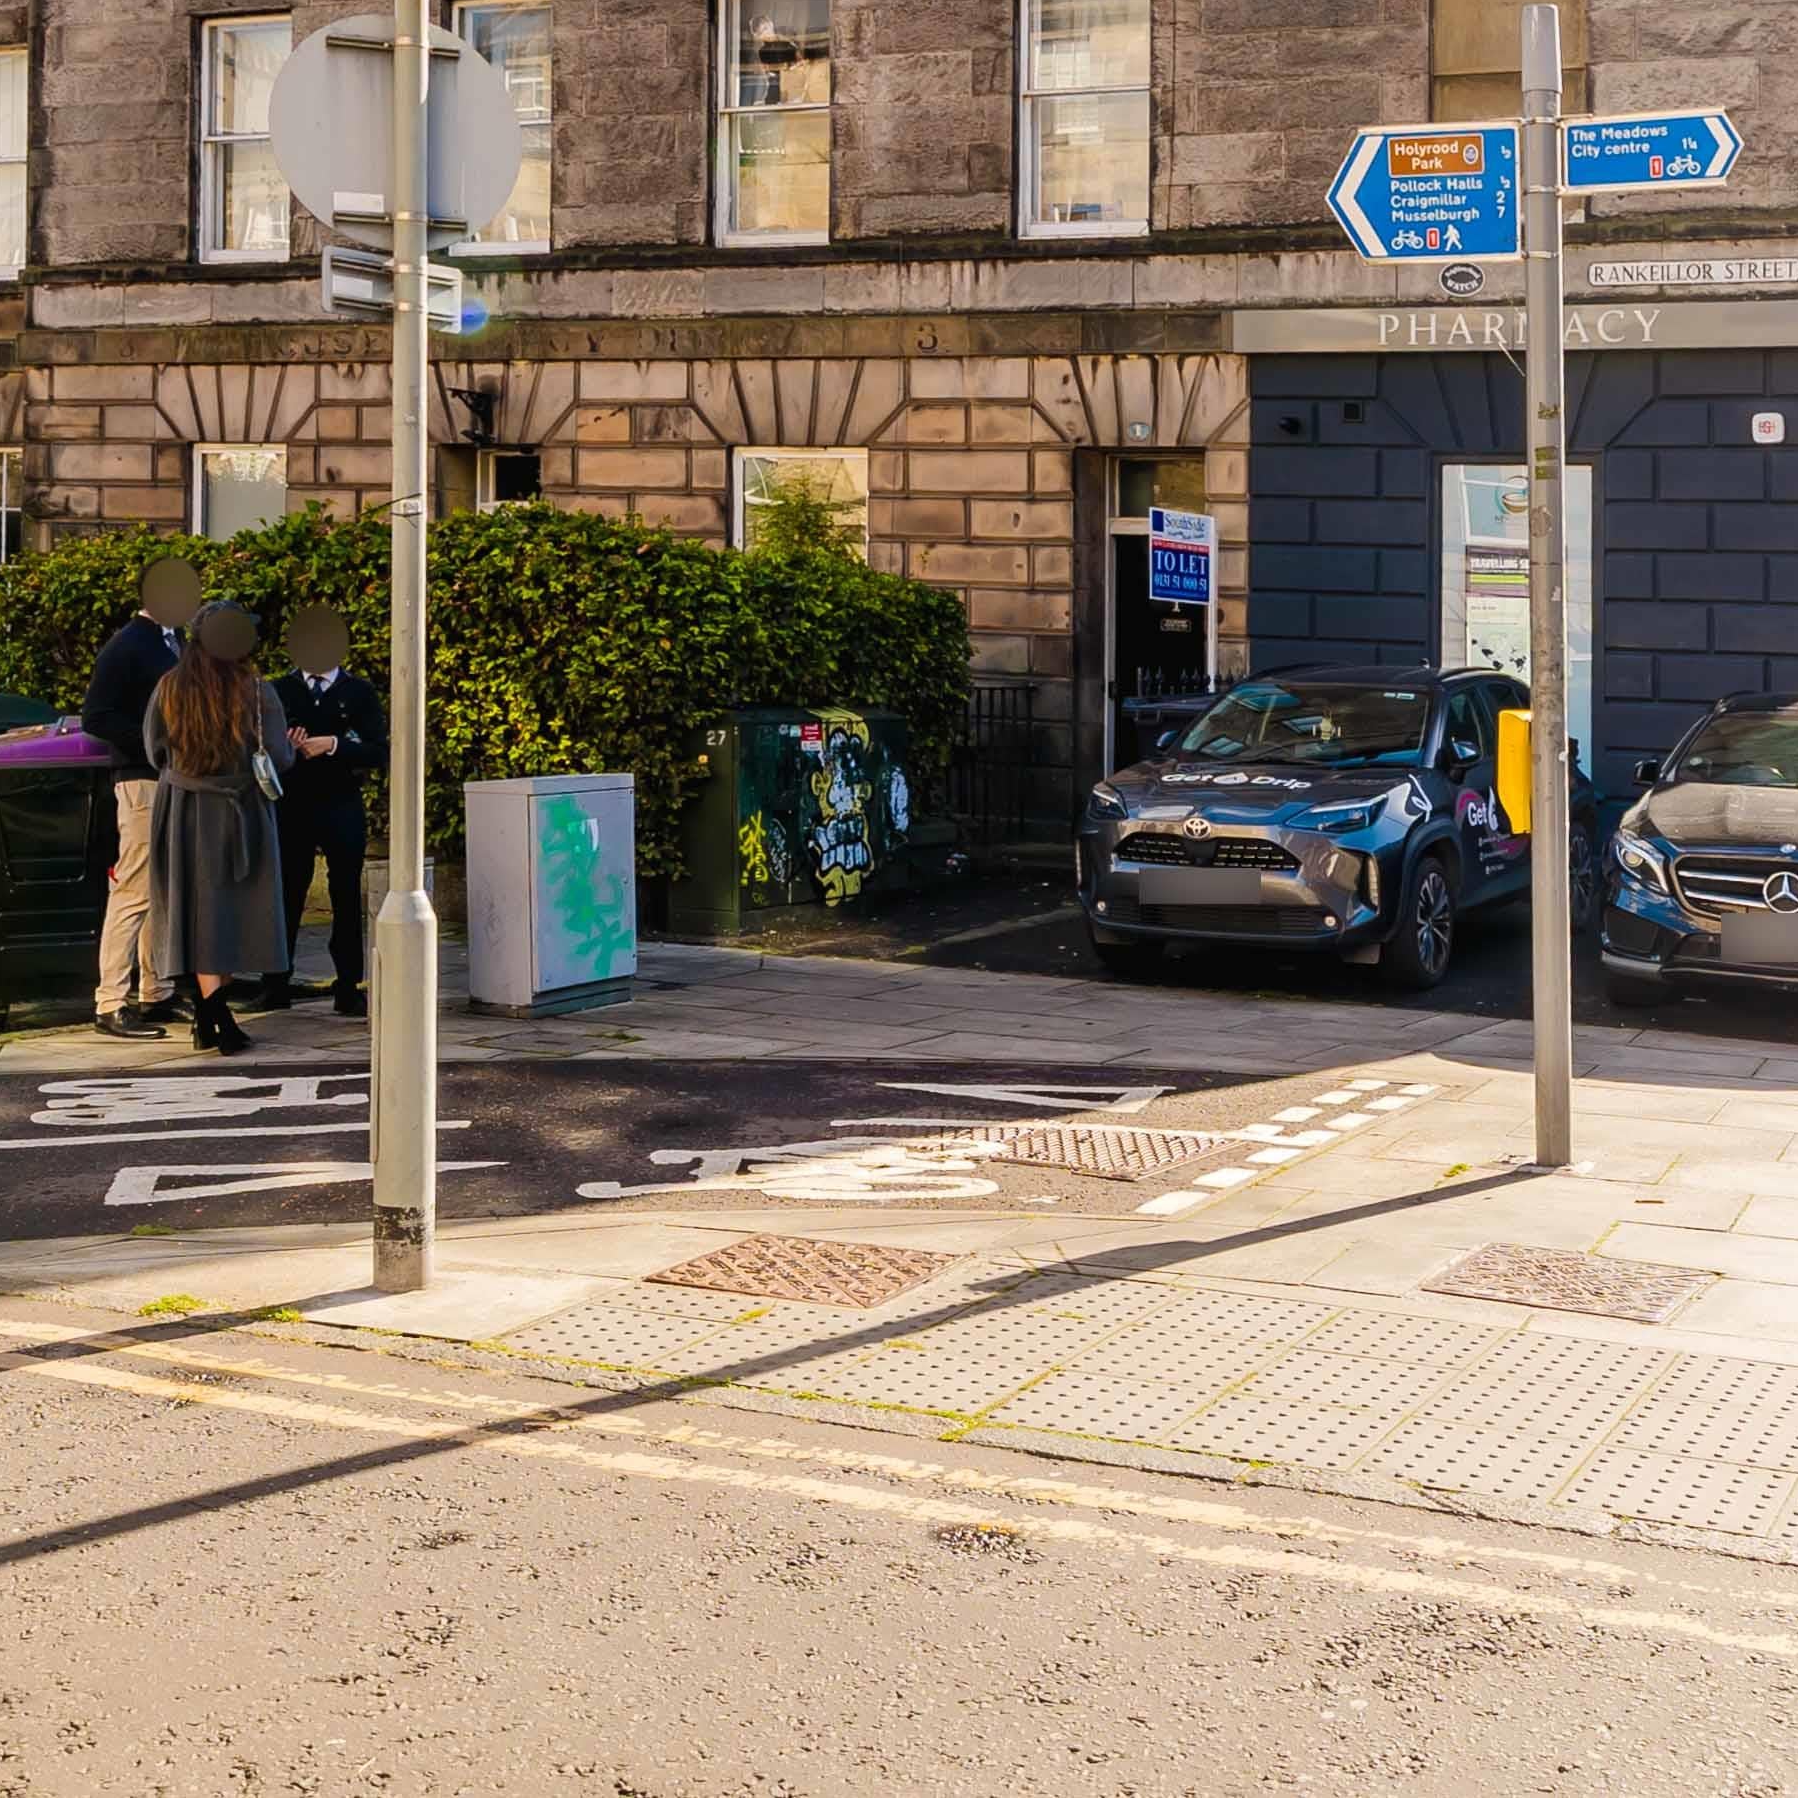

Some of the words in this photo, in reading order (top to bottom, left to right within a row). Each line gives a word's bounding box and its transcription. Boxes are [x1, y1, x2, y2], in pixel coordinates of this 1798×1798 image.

[1571, 129, 1596, 142] The
[1601, 125, 1668, 140] Meadows
[1394, 141, 1459, 157] Holyrood
[1571, 144, 1600, 159] City
[1604, 142, 1651, 155] centre
[1411, 157, 1443, 170] Park
[1390, 179, 1442, 193] Pollock
[1447, 177, 1483, 191] Halls
[1390, 194, 1467, 209] Craigmillar
[1495, 190, 1506, 204] 2
[1391, 207, 1480, 223] Musselburgh
[1496, 205, 1506, 219] 7
[1593, 263, 1714, 283] RANKEILLOR
[1724, 261, 1796, 280] STREET
[1378, 309, 1661, 347] PHARACY
[1154, 550, 1176, 571] TO
[1179, 553, 1207, 575] LET
[706, 730, 726, 746] 27
[1161, 773, 1213, 783] Get
[1249, 775, 1313, 790] Drip
[1467, 801, 1488, 828] Get
